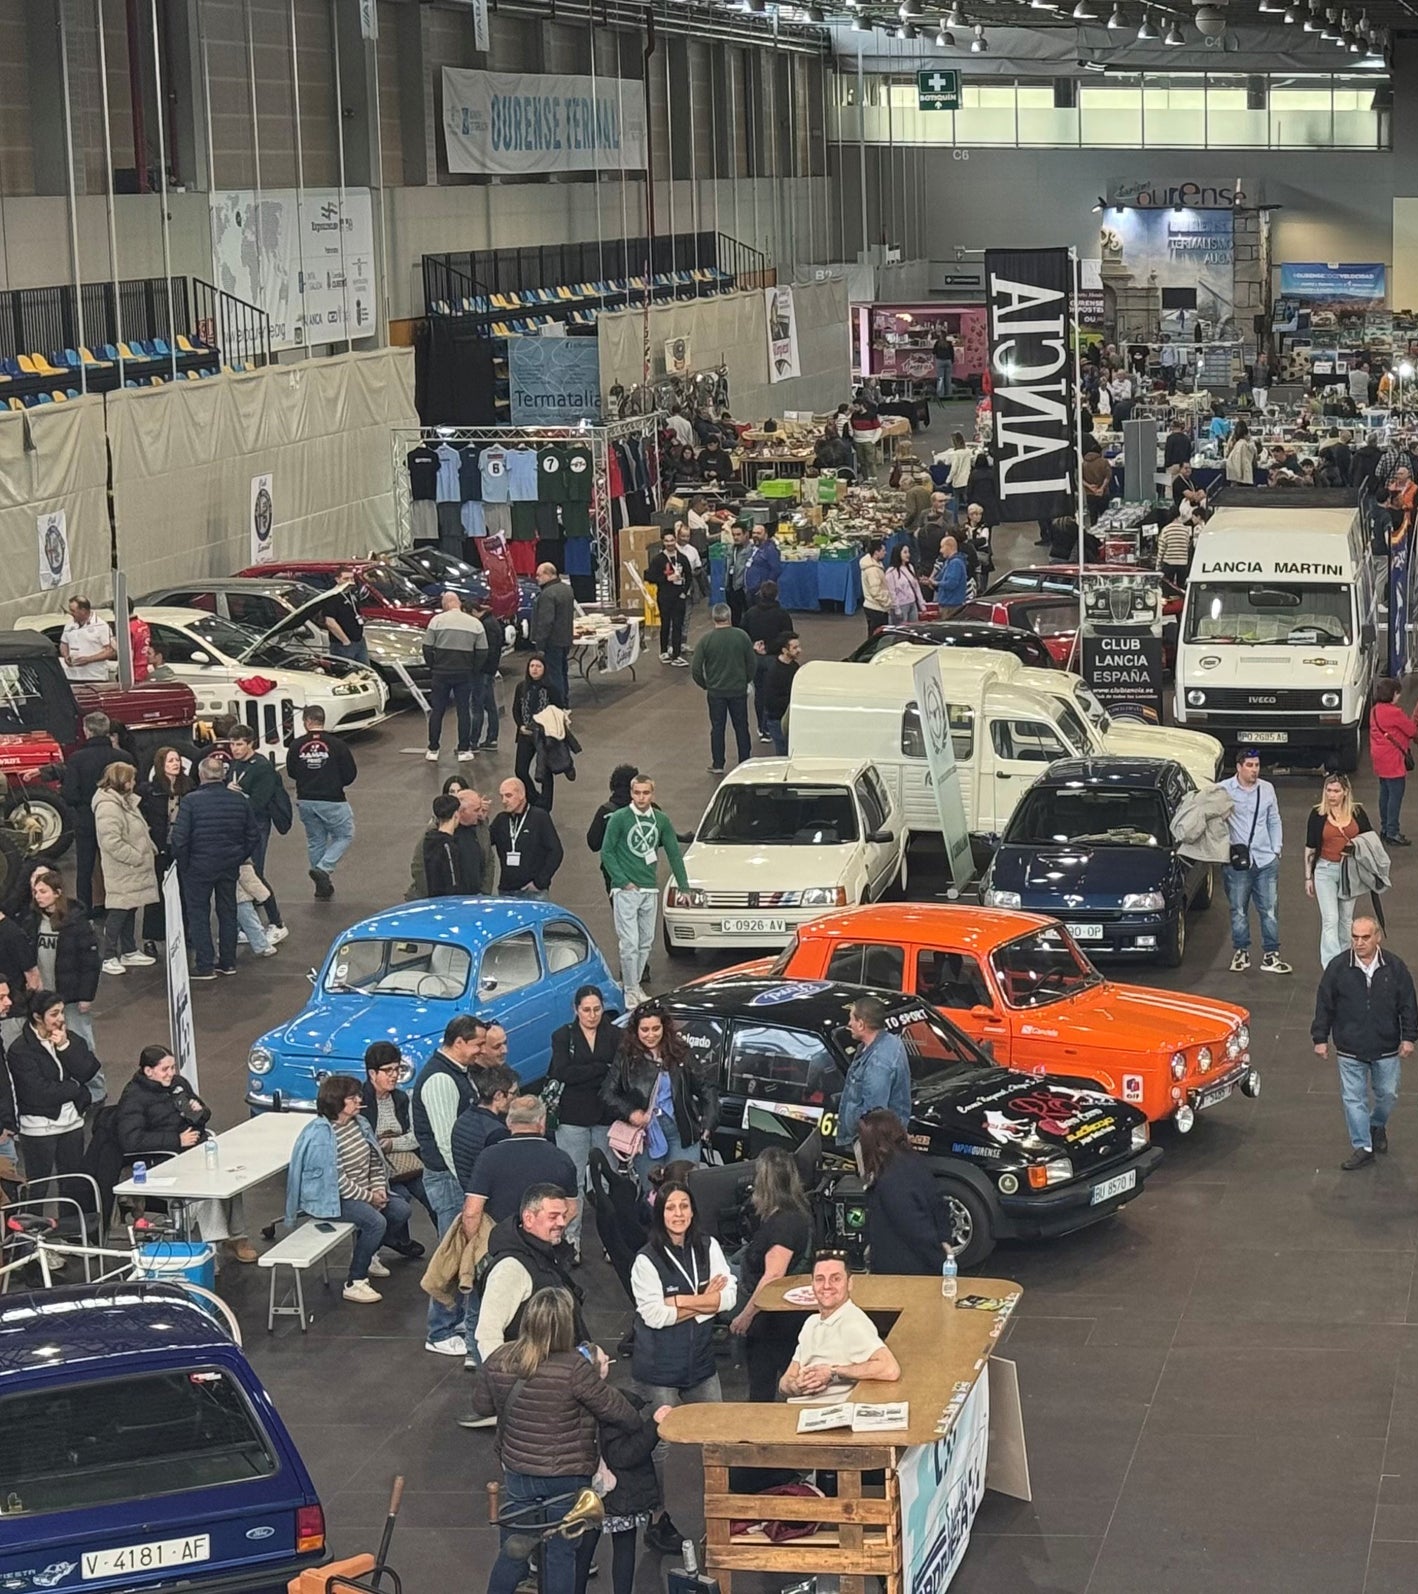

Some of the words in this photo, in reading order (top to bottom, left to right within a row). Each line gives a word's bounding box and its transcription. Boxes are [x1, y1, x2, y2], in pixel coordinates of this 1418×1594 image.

[1205, 36, 1222, 47] C4
[490, 94, 562, 151] OURENSE
[953, 150, 969, 161] C6
[514, 390, 601, 409] Termatalia
[1201, 561, 1263, 574] LANCIA
[1274, 562, 1343, 576] MARTINI
[1101, 638, 1141, 650] CLUB
[1095, 654, 1149, 667] LANCIA
[1093, 668, 1151, 683] ESPAÑA
[1248, 696, 1277, 704] IVECO
[736, 920, 765, 931] 0926
[769, 921, 783, 932] AV
[899, 1009, 929, 1027] SPORT
[1107, 1176, 1127, 1196] 8570
[86, 1554, 98, 1576] V
[113, 1545, 163, 1571] 4181
[181, 1537, 207, 1561] AF
